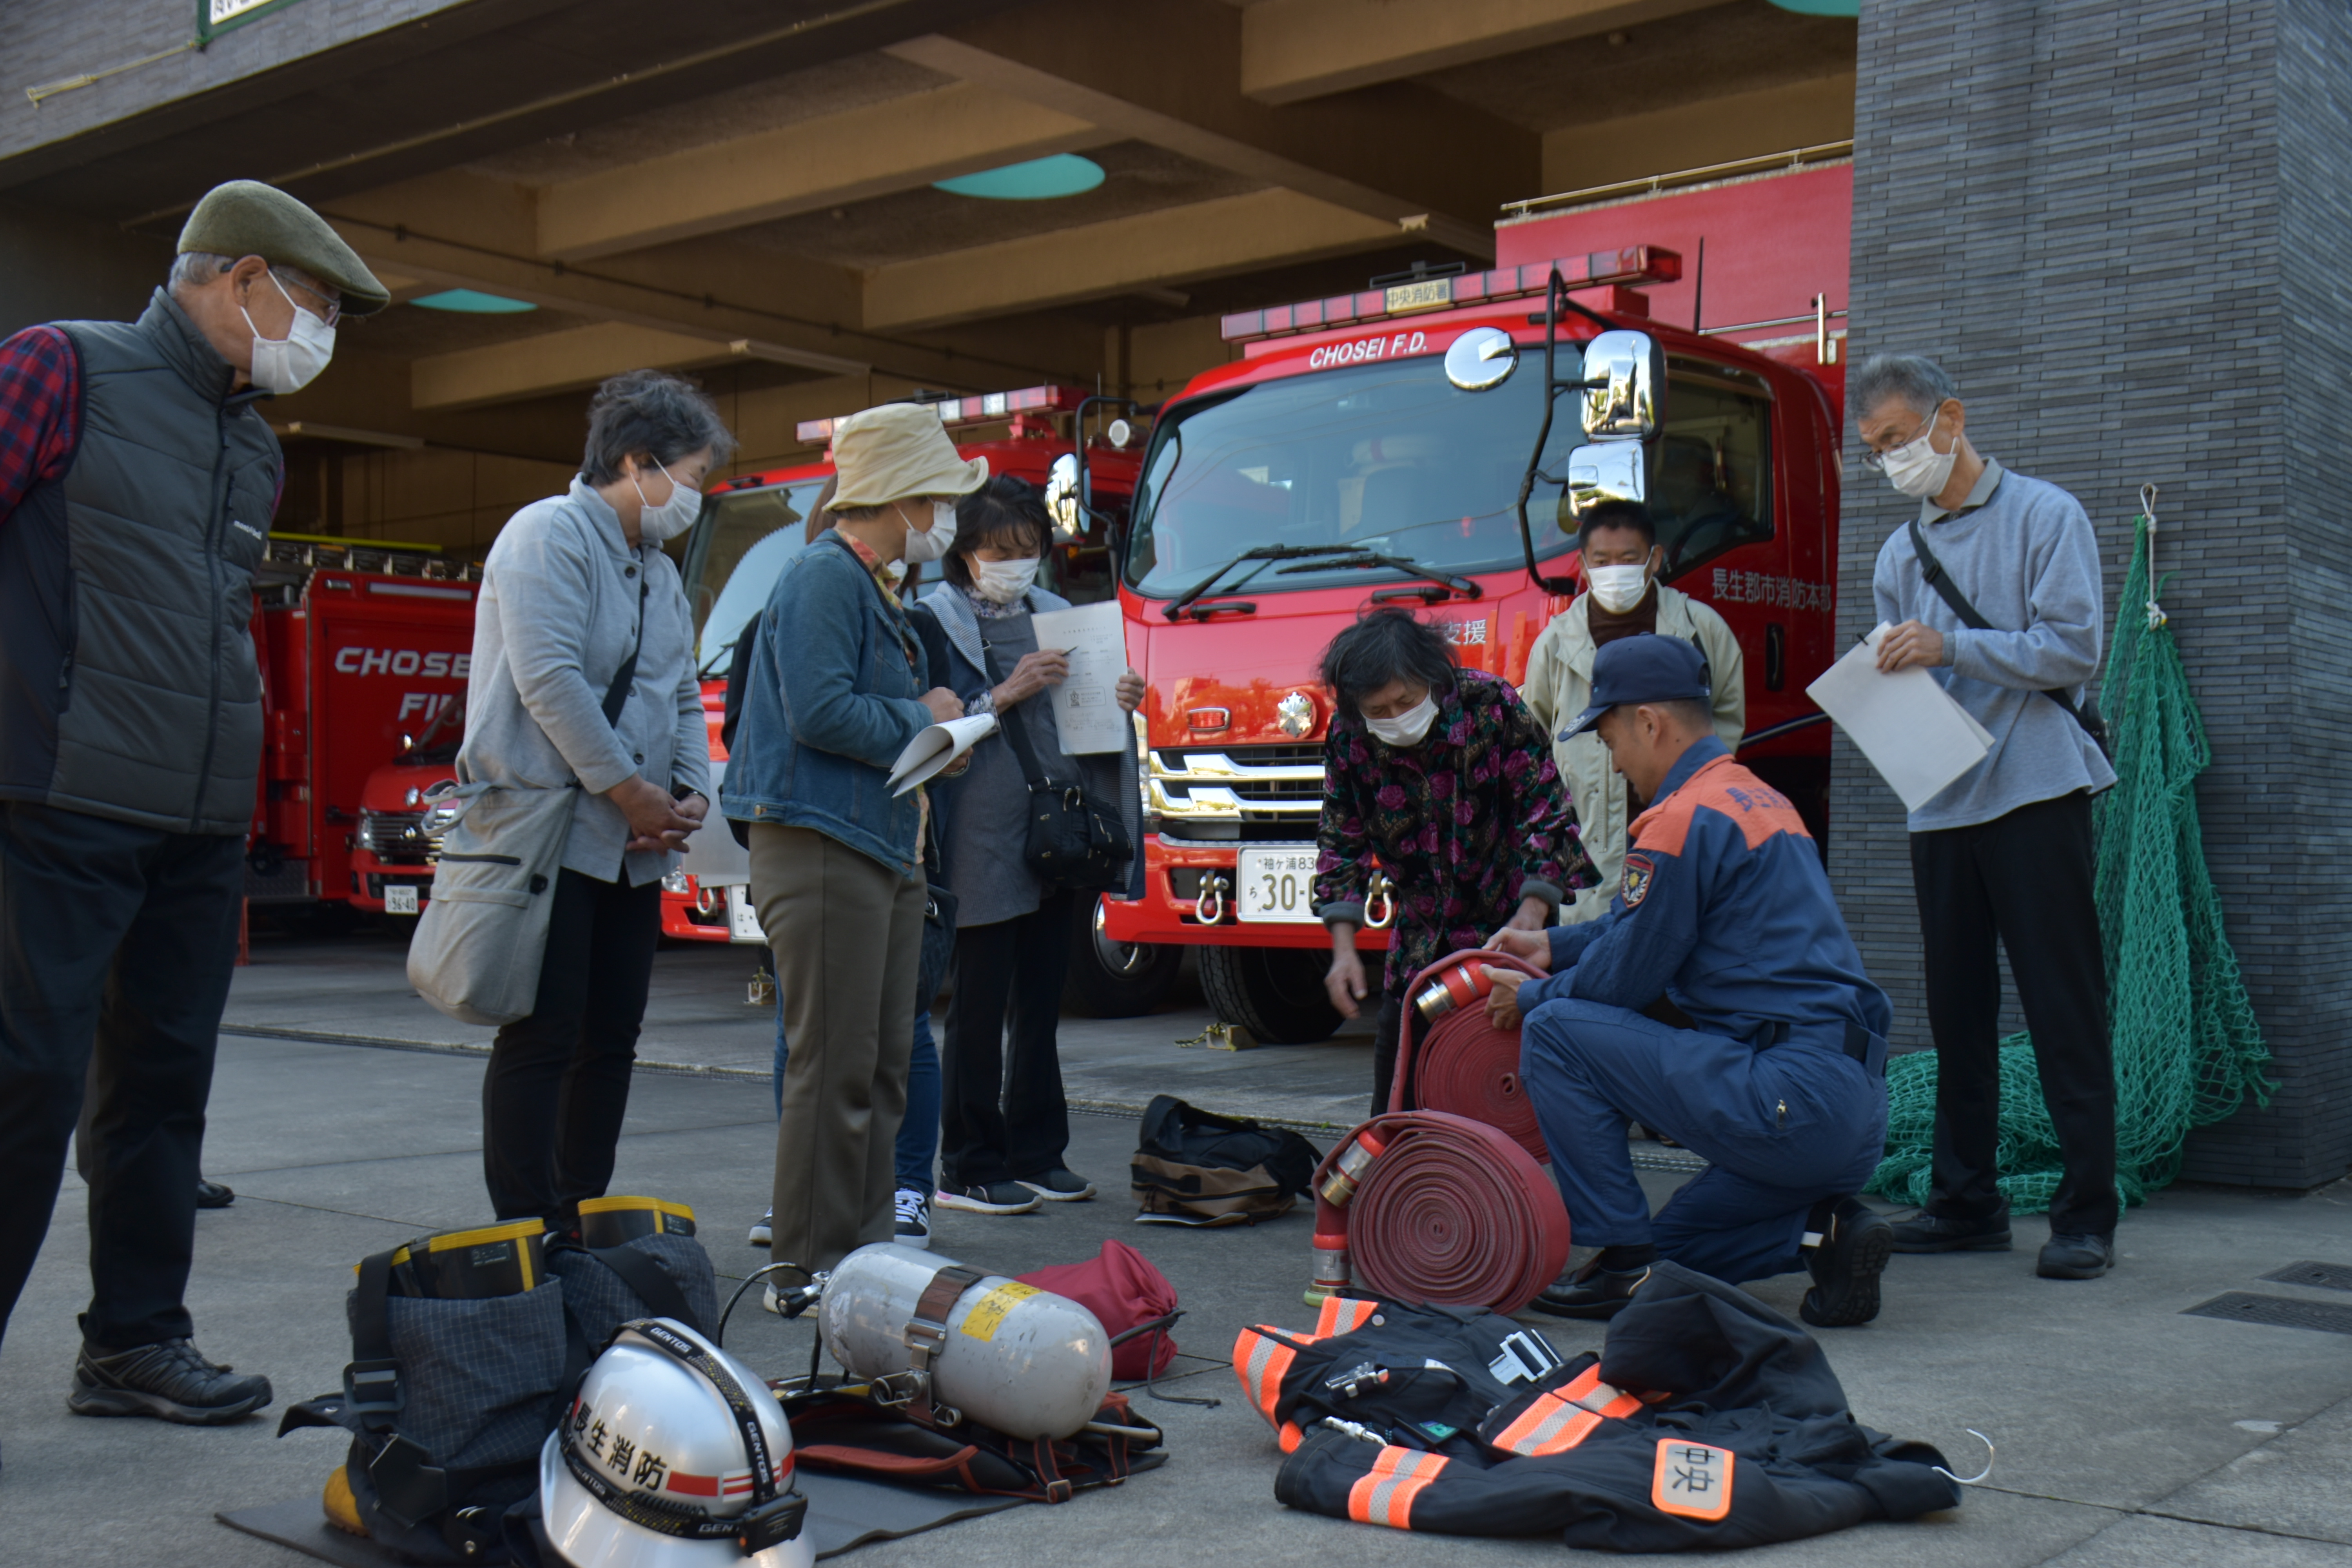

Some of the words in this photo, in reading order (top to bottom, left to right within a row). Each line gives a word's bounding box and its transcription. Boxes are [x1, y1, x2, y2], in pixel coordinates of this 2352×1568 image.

[1387, 281, 1447, 307] 中央消防署
[1309, 336, 1387, 369] CHOSEI
[1391, 331, 1427, 356] F.D.
[1712, 568, 1832, 613] 長生郡市消防本部
[1435, 618, 1486, 646] 支援
[1249, 886, 1257, 898] ち
[650, 1327, 693, 1354] GENTOS
[573, 1401, 668, 1491] 長生消防
[746, 1421, 770, 1484] GENTOS
[572, 1463, 607, 1495] ENTOS
[1672, 1447, 1716, 1492] 中央
